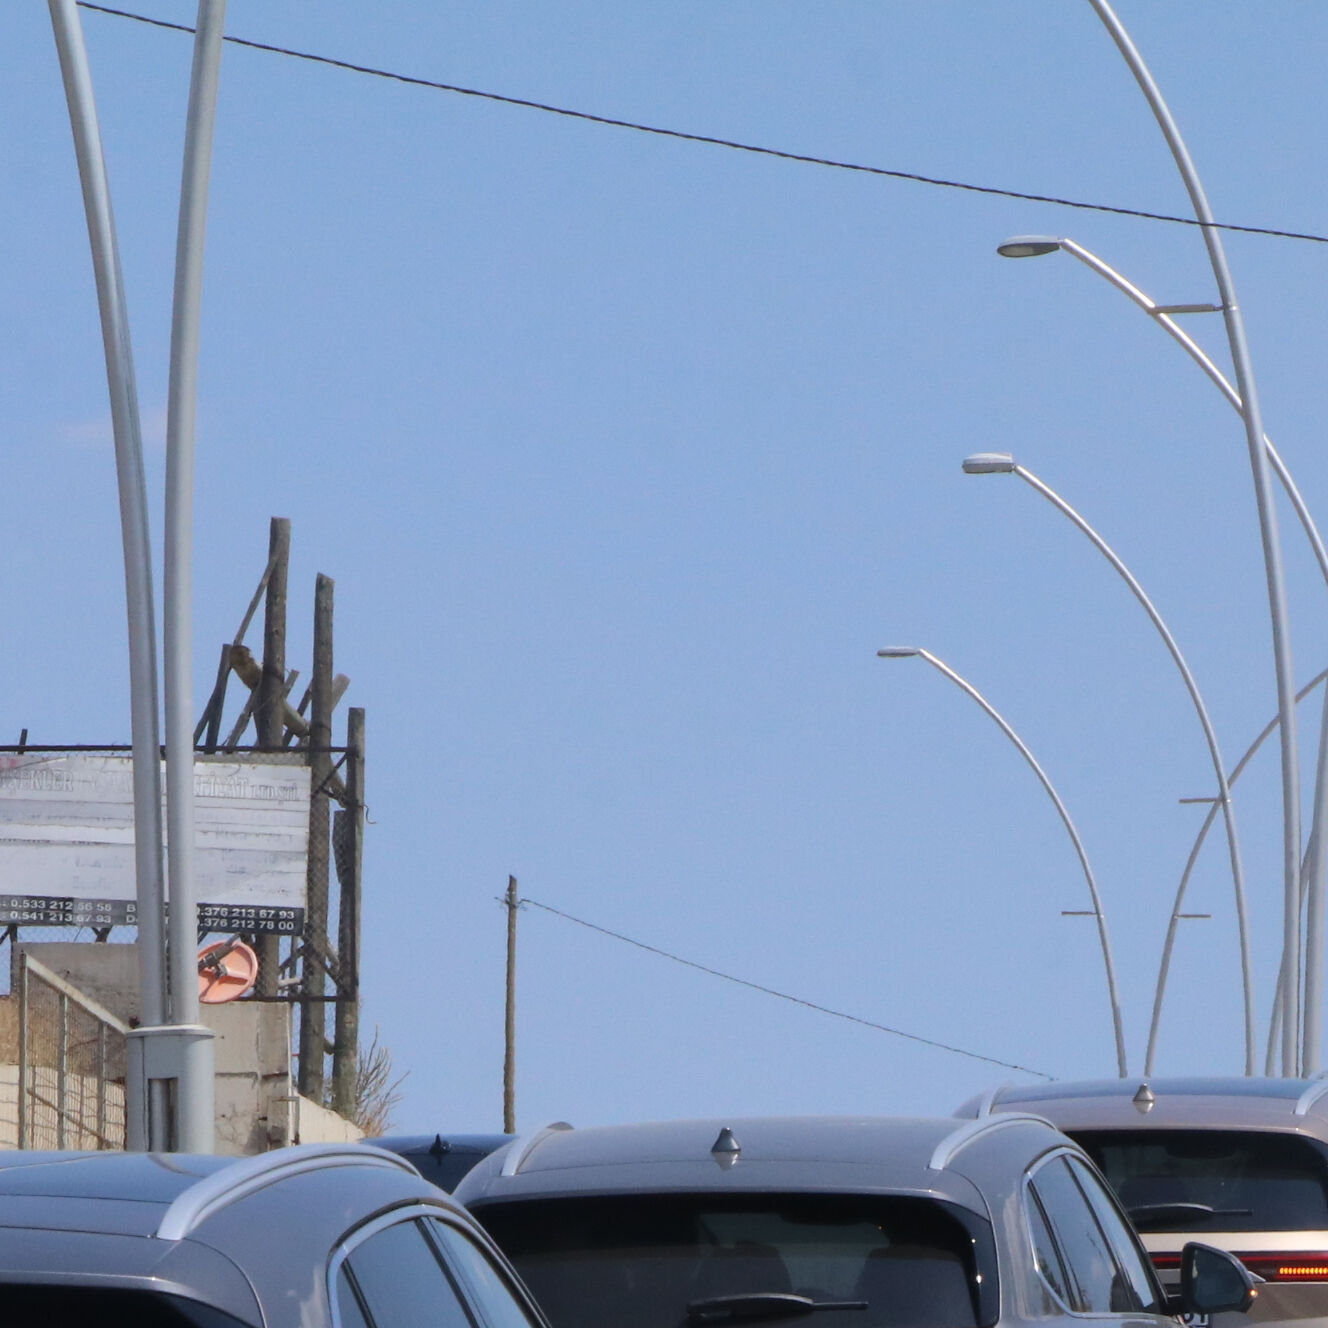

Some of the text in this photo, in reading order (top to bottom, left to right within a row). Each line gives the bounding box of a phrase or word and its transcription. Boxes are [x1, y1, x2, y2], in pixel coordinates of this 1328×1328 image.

[11, 899, 46, 909] 0.533
[49, 901, 73, 911] 212
[10, 910, 44, 921] 0.541
[48, 912, 72, 922] 213
[231, 908, 255, 919] 213
[279, 910, 295, 919] 93
[231, 920, 255, 929] 212
[259, 920, 275, 930] 78
[278, 921, 295, 930] 00
